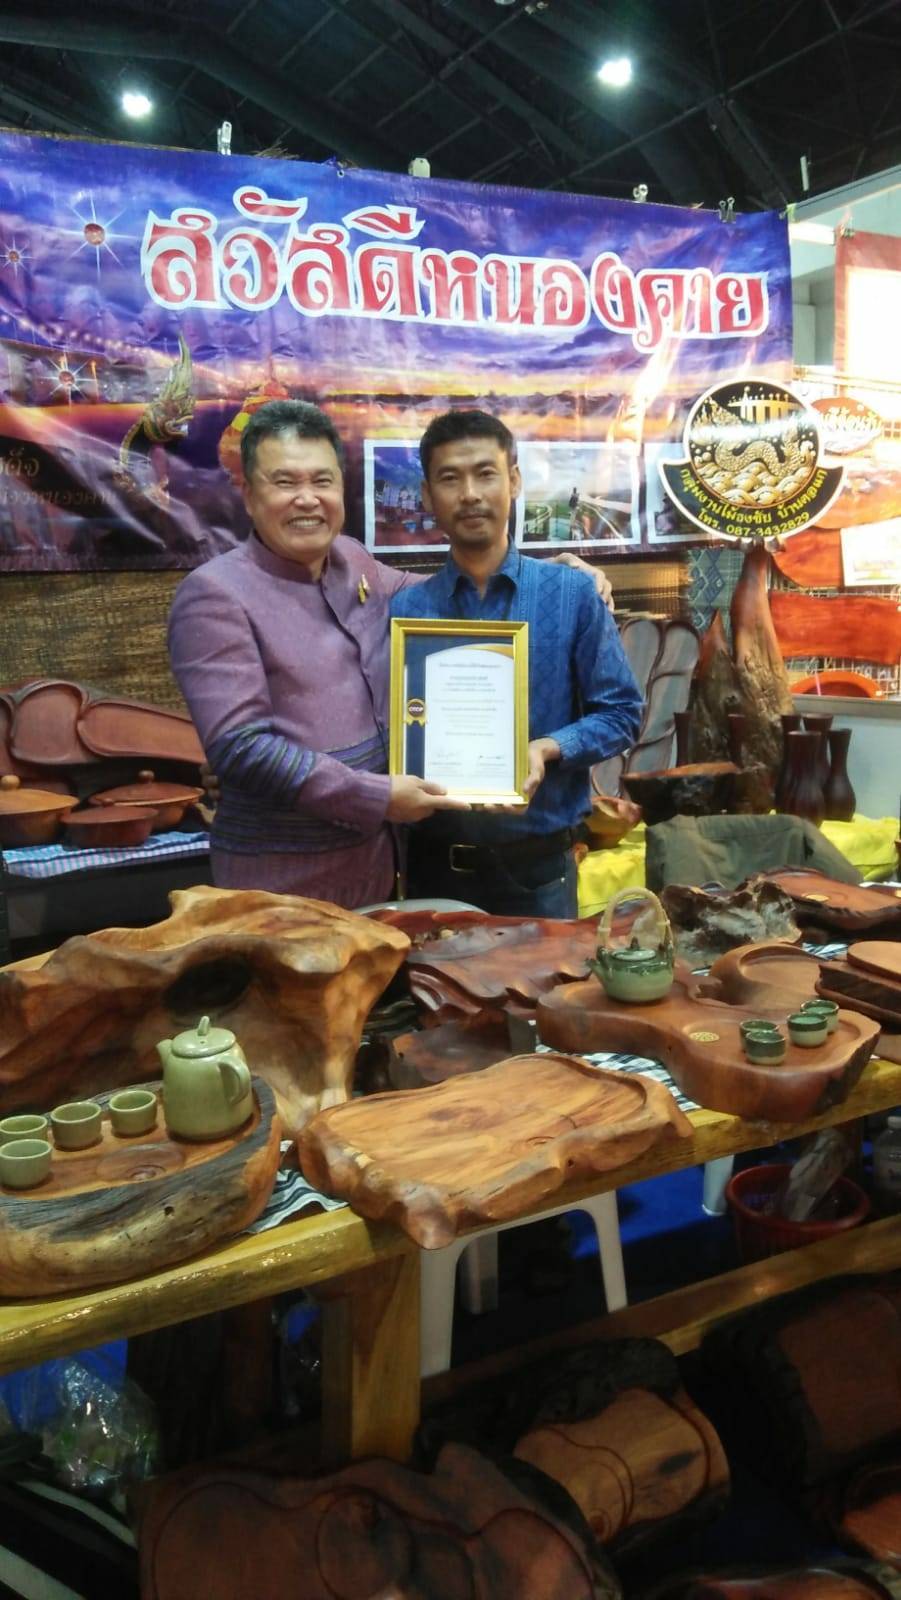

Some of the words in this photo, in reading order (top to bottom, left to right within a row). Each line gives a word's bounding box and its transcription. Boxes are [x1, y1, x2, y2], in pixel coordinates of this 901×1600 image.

[143, 188, 765, 350] สวัสดีหนองคาย
[726, 511, 810, 537] 087-3432829
